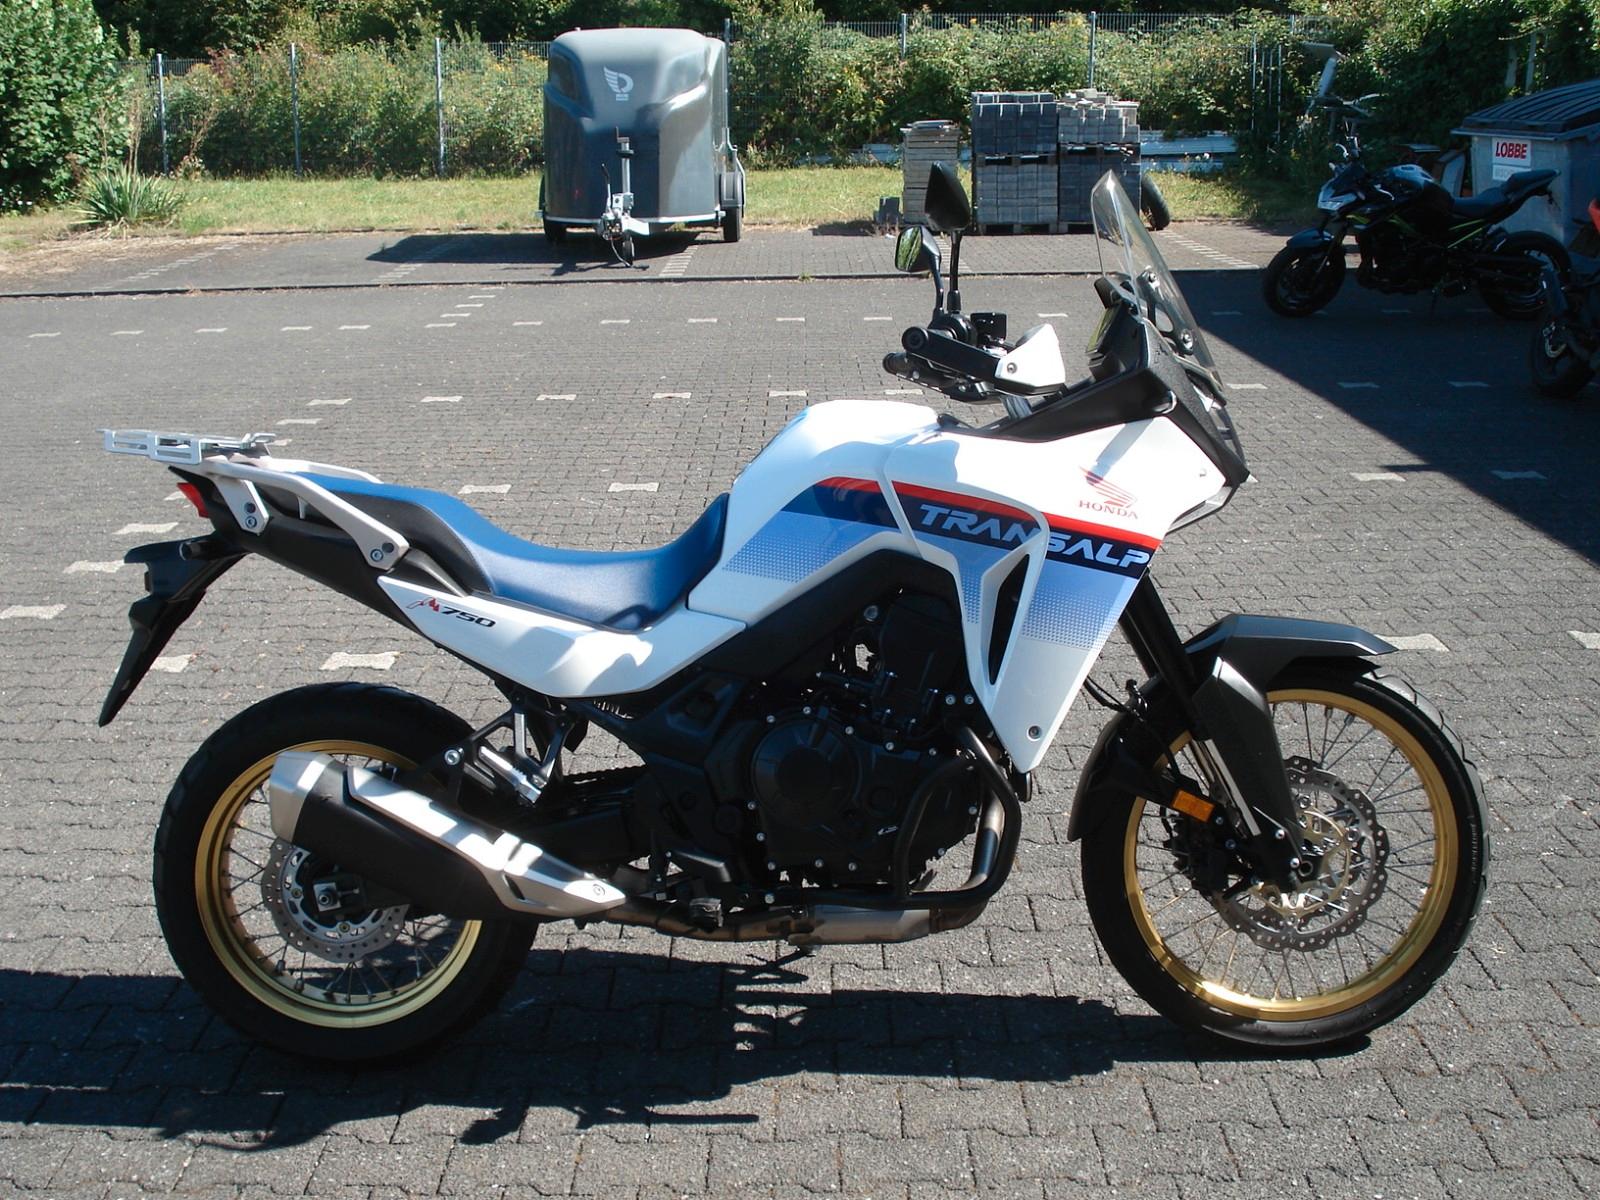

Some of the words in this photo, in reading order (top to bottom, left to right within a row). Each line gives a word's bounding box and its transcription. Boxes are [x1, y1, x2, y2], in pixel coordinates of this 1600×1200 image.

[1495, 142, 1528, 158] LOBBE
[1079, 500, 1138, 519] HONDA
[919, 503, 1150, 568] TRANSALP
